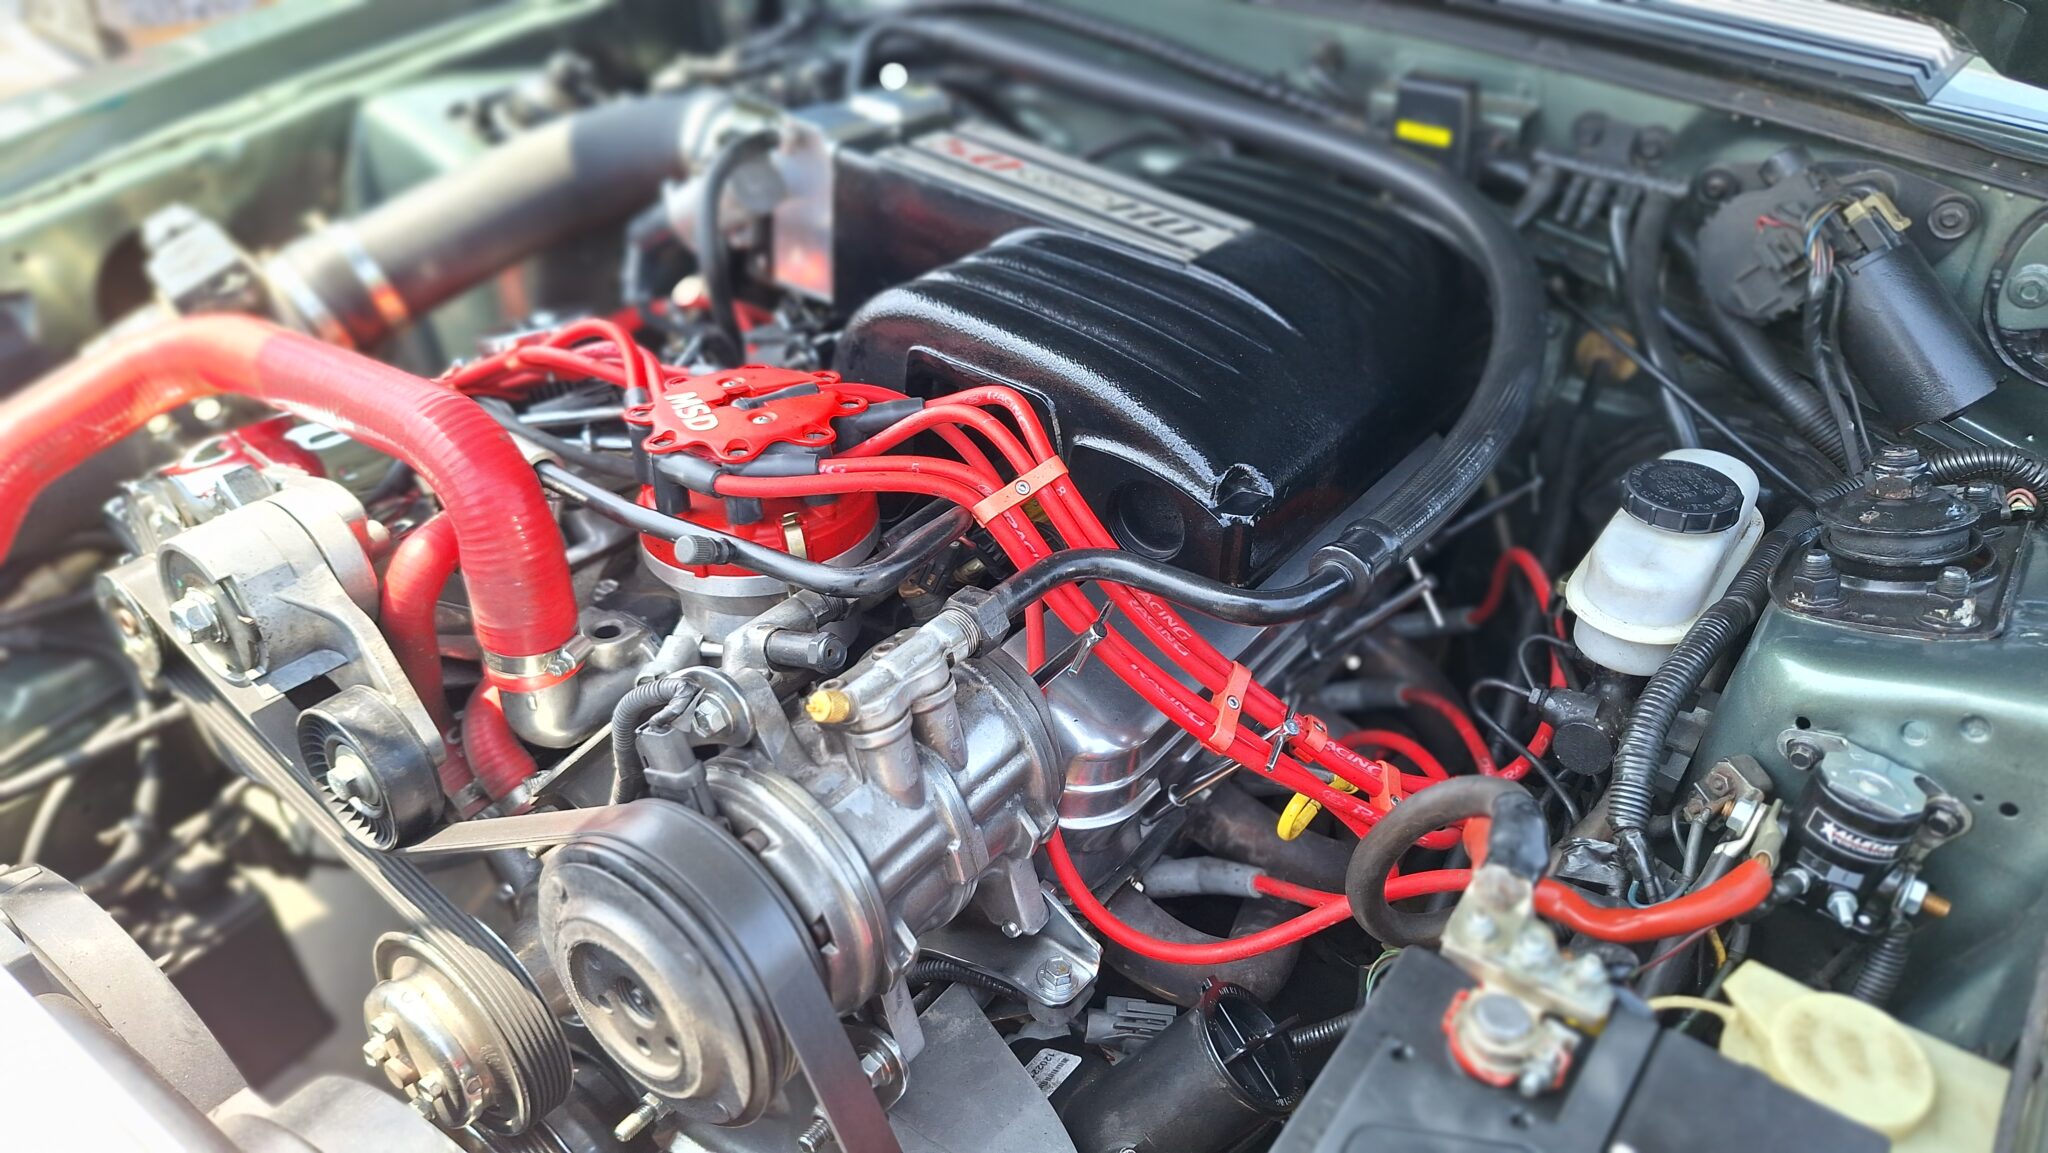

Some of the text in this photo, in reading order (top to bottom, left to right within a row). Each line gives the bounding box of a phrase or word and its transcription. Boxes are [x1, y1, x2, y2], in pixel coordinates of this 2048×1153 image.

[663, 391, 719, 431] MSD
[1128, 599, 1189, 656] RACING
[1134, 588, 1192, 641] ACING
[1324, 740, 1383, 778] ACING
